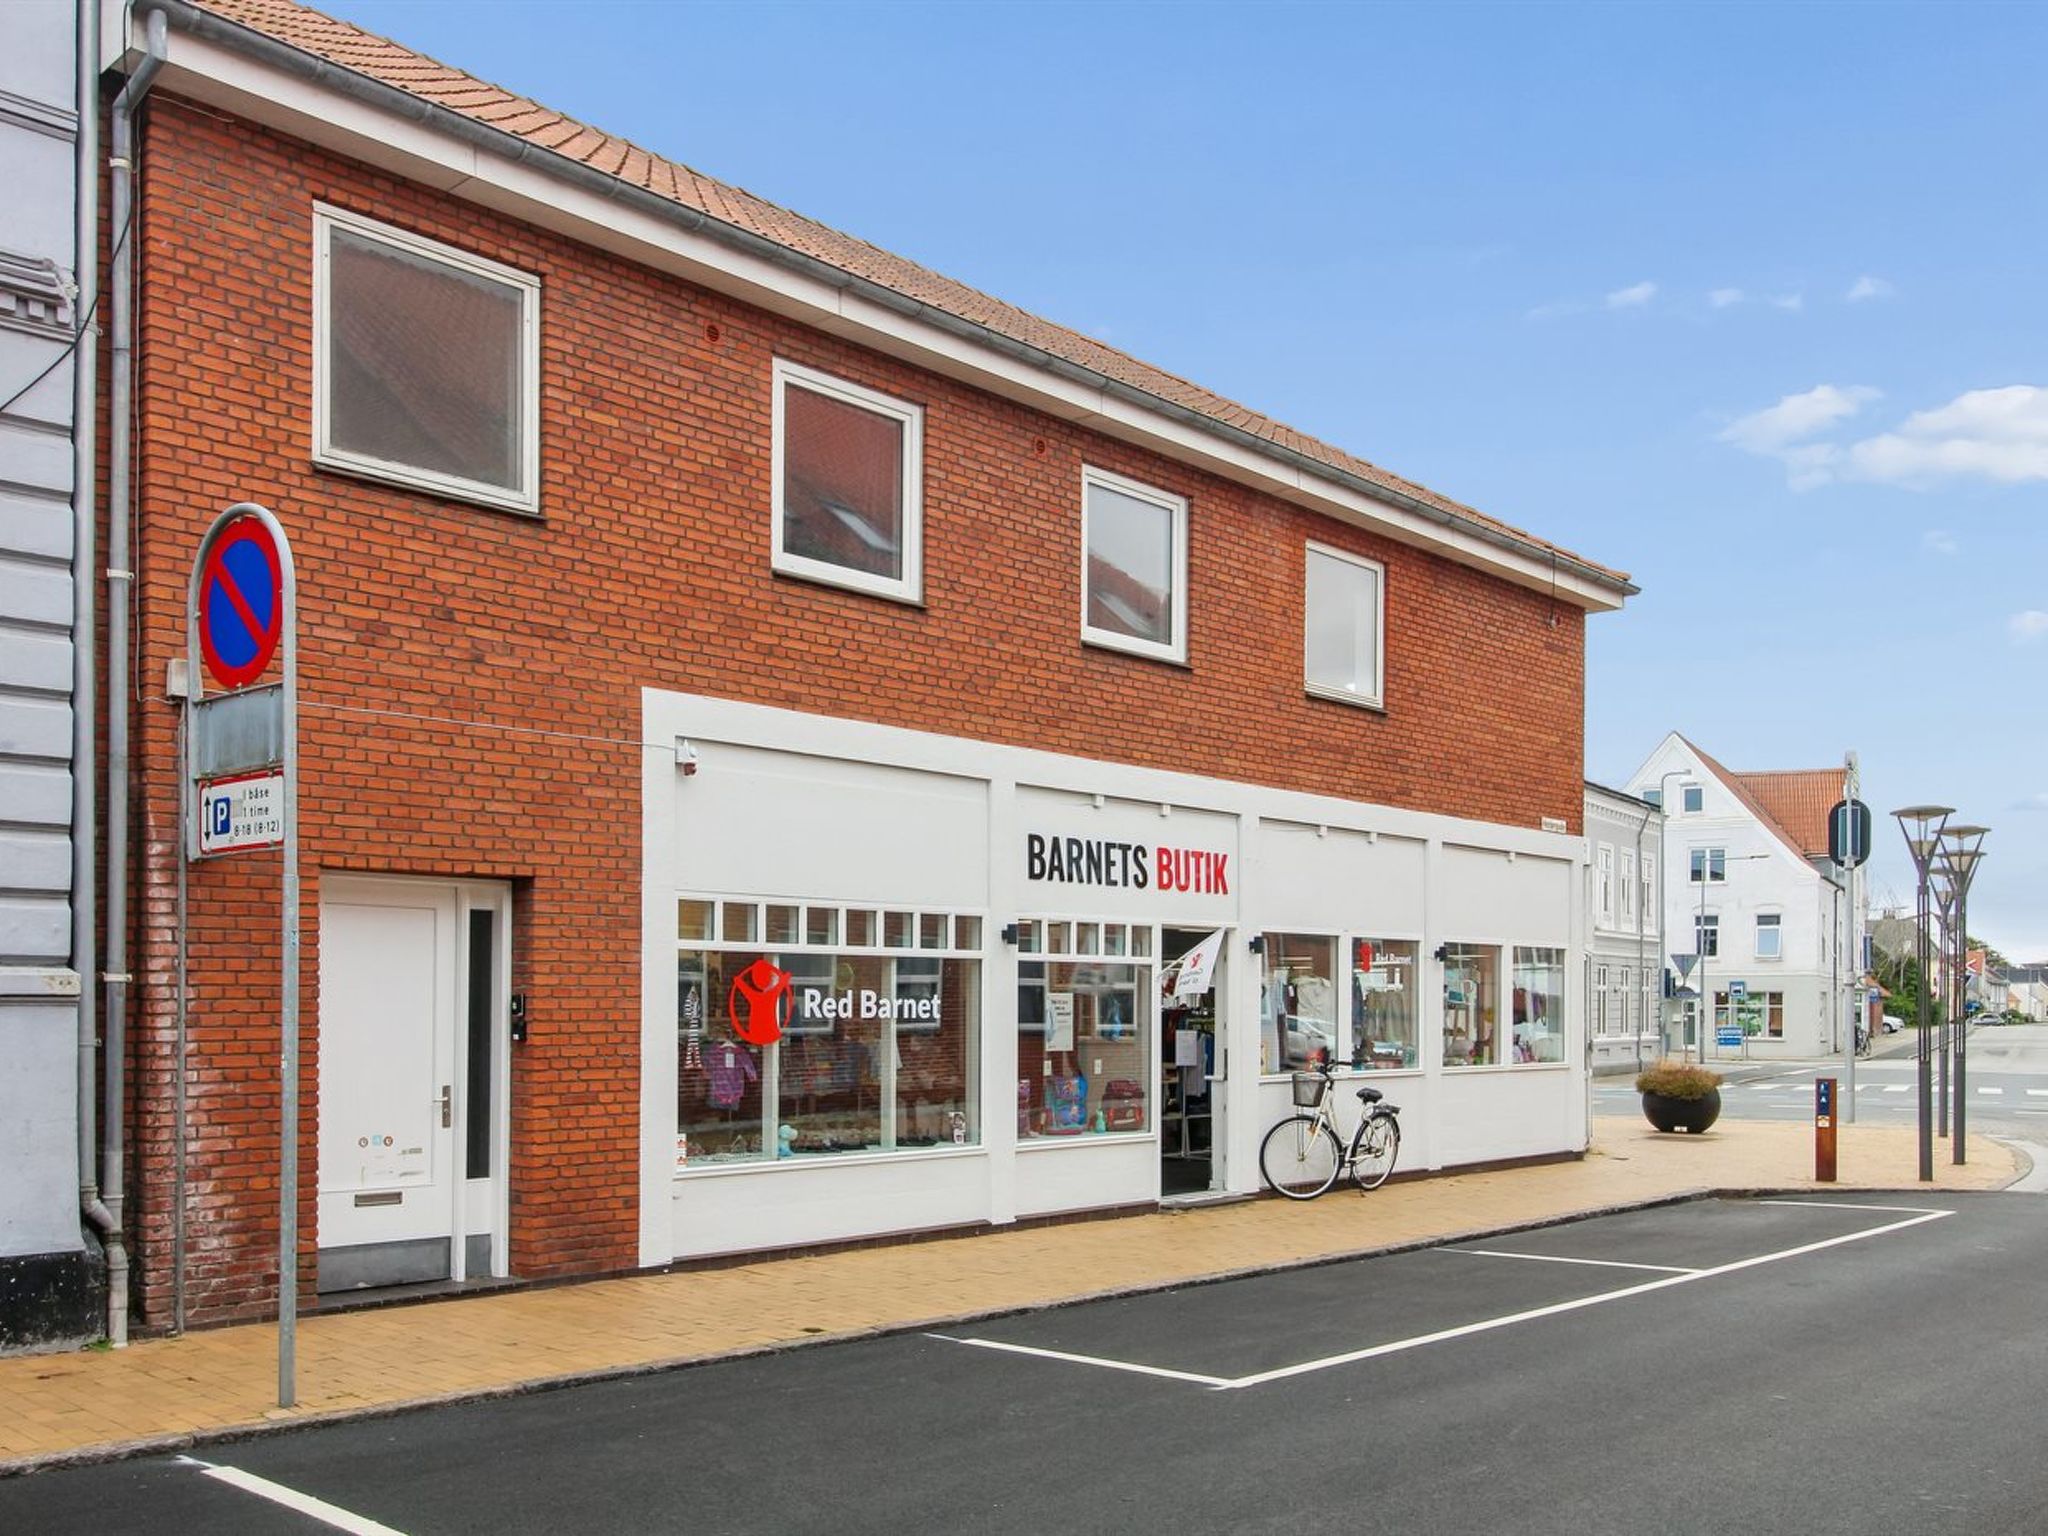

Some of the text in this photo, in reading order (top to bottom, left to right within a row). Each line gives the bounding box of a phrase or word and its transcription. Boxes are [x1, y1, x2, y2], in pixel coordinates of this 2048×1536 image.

[249, 787, 269, 800] båse
[217, 802, 228, 831] P
[250, 805, 269, 817] time
[1027, 833, 1229, 895] BARNETS BUTIK
[804, 988, 941, 1019] Red Barnet
